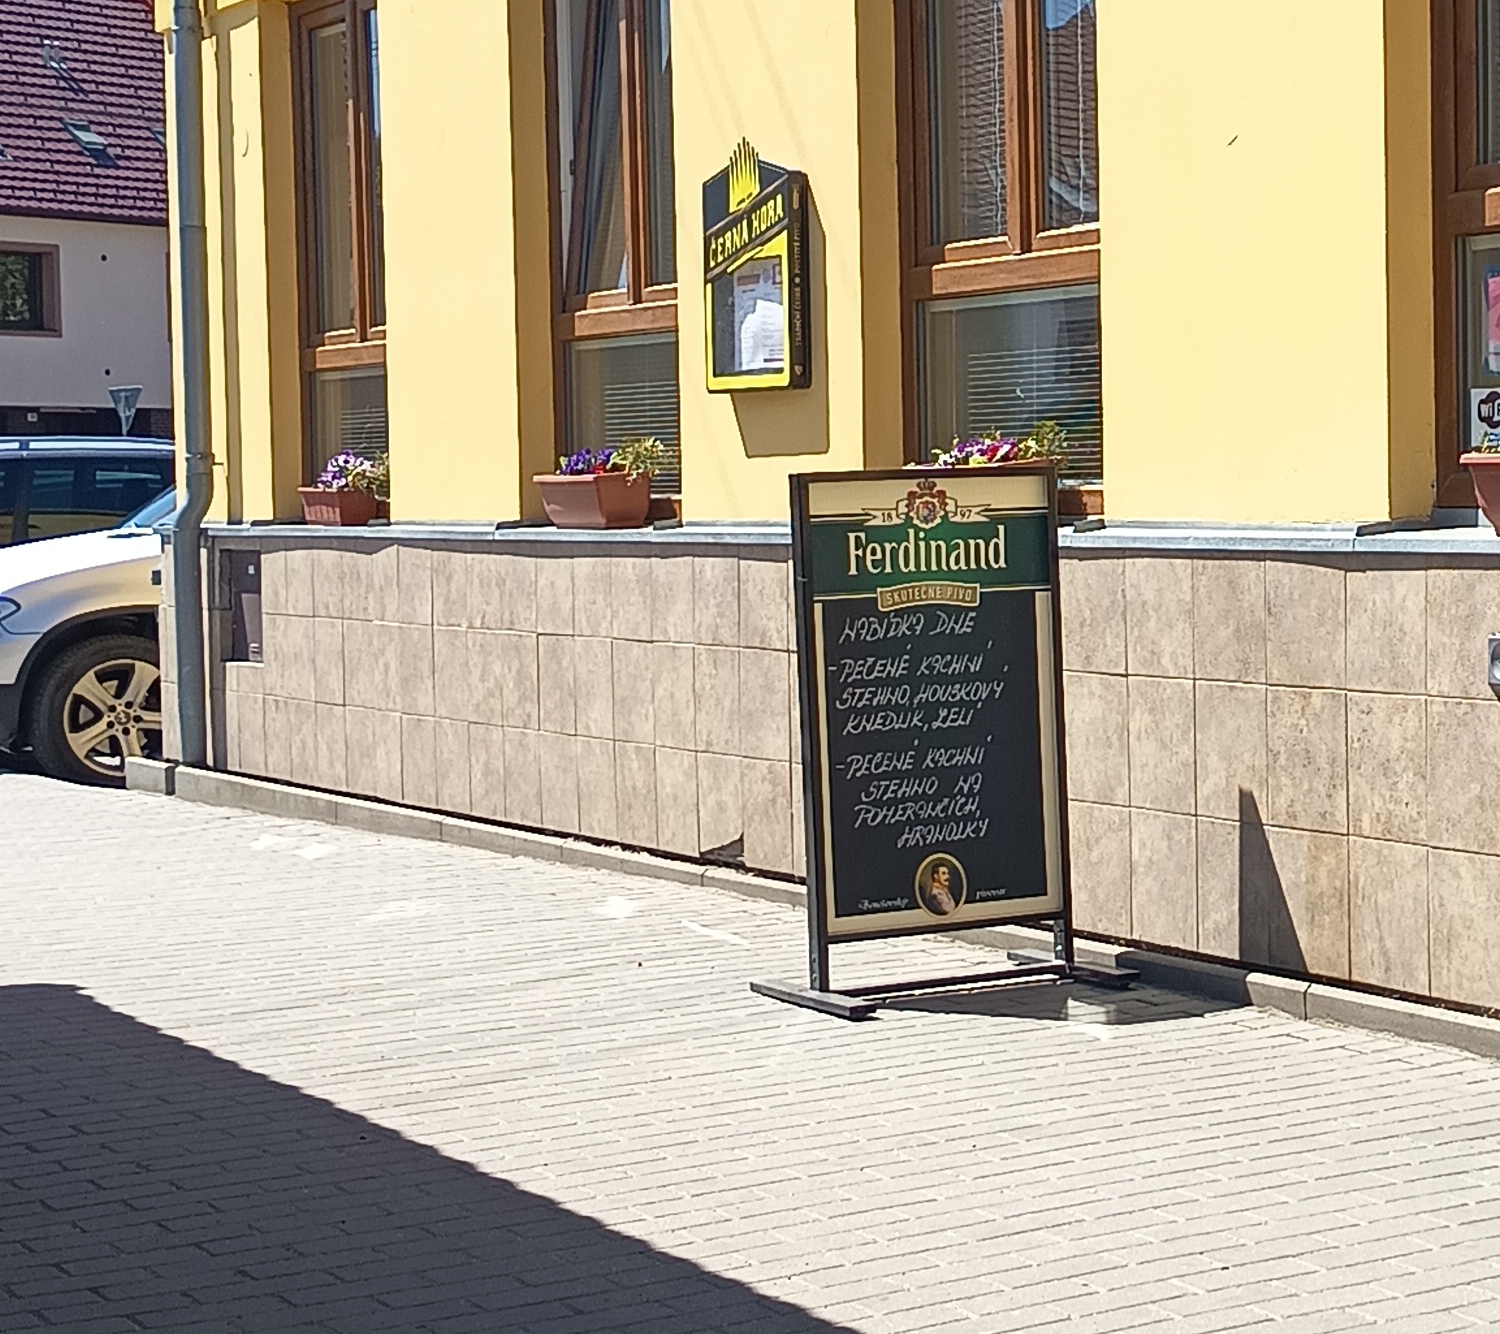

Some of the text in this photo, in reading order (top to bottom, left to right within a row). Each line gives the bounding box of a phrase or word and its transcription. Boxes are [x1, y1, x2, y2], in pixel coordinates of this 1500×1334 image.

[709, 193, 784, 269] ČERNÁ HORA
[881, 509, 973, 523] 18 97
[847, 525, 1008, 576] Ferdinand
[886, 585, 973, 605] SKUTEČNÉ PIVO
[839, 611, 977, 644] NABÍDKA DNE
[861, 772, 982, 802] STEHNO NA
[897, 818, 990, 849] HRANOLKY
